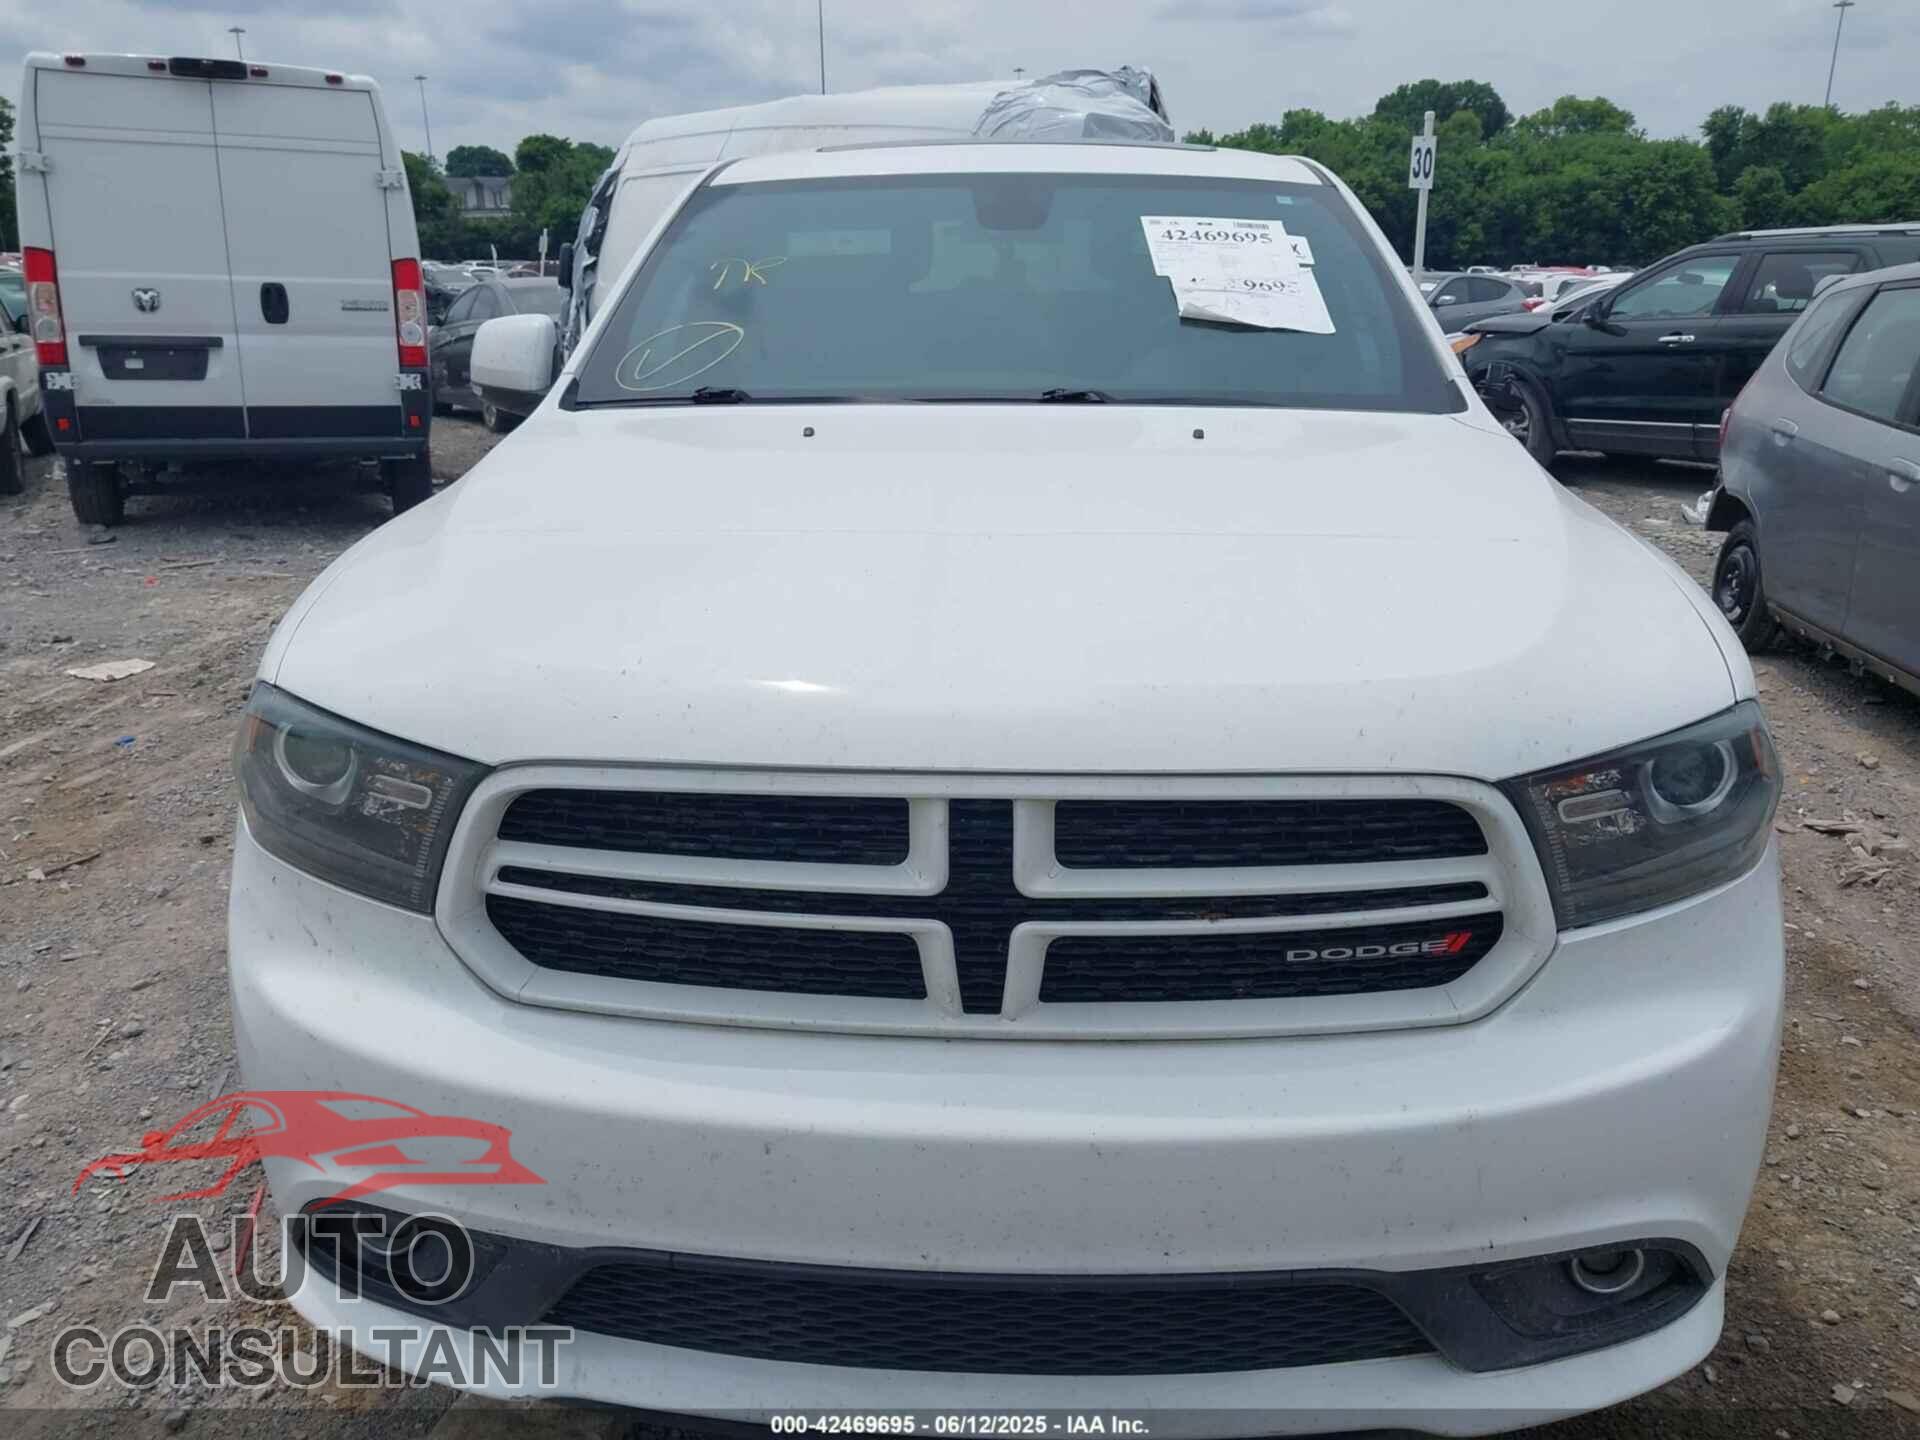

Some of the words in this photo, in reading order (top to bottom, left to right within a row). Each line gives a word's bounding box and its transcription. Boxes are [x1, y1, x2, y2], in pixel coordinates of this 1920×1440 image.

[1412, 146, 1433, 180] 30
[1161, 228, 1273, 246] 42469695
[1286, 938, 1449, 962] DODGE
